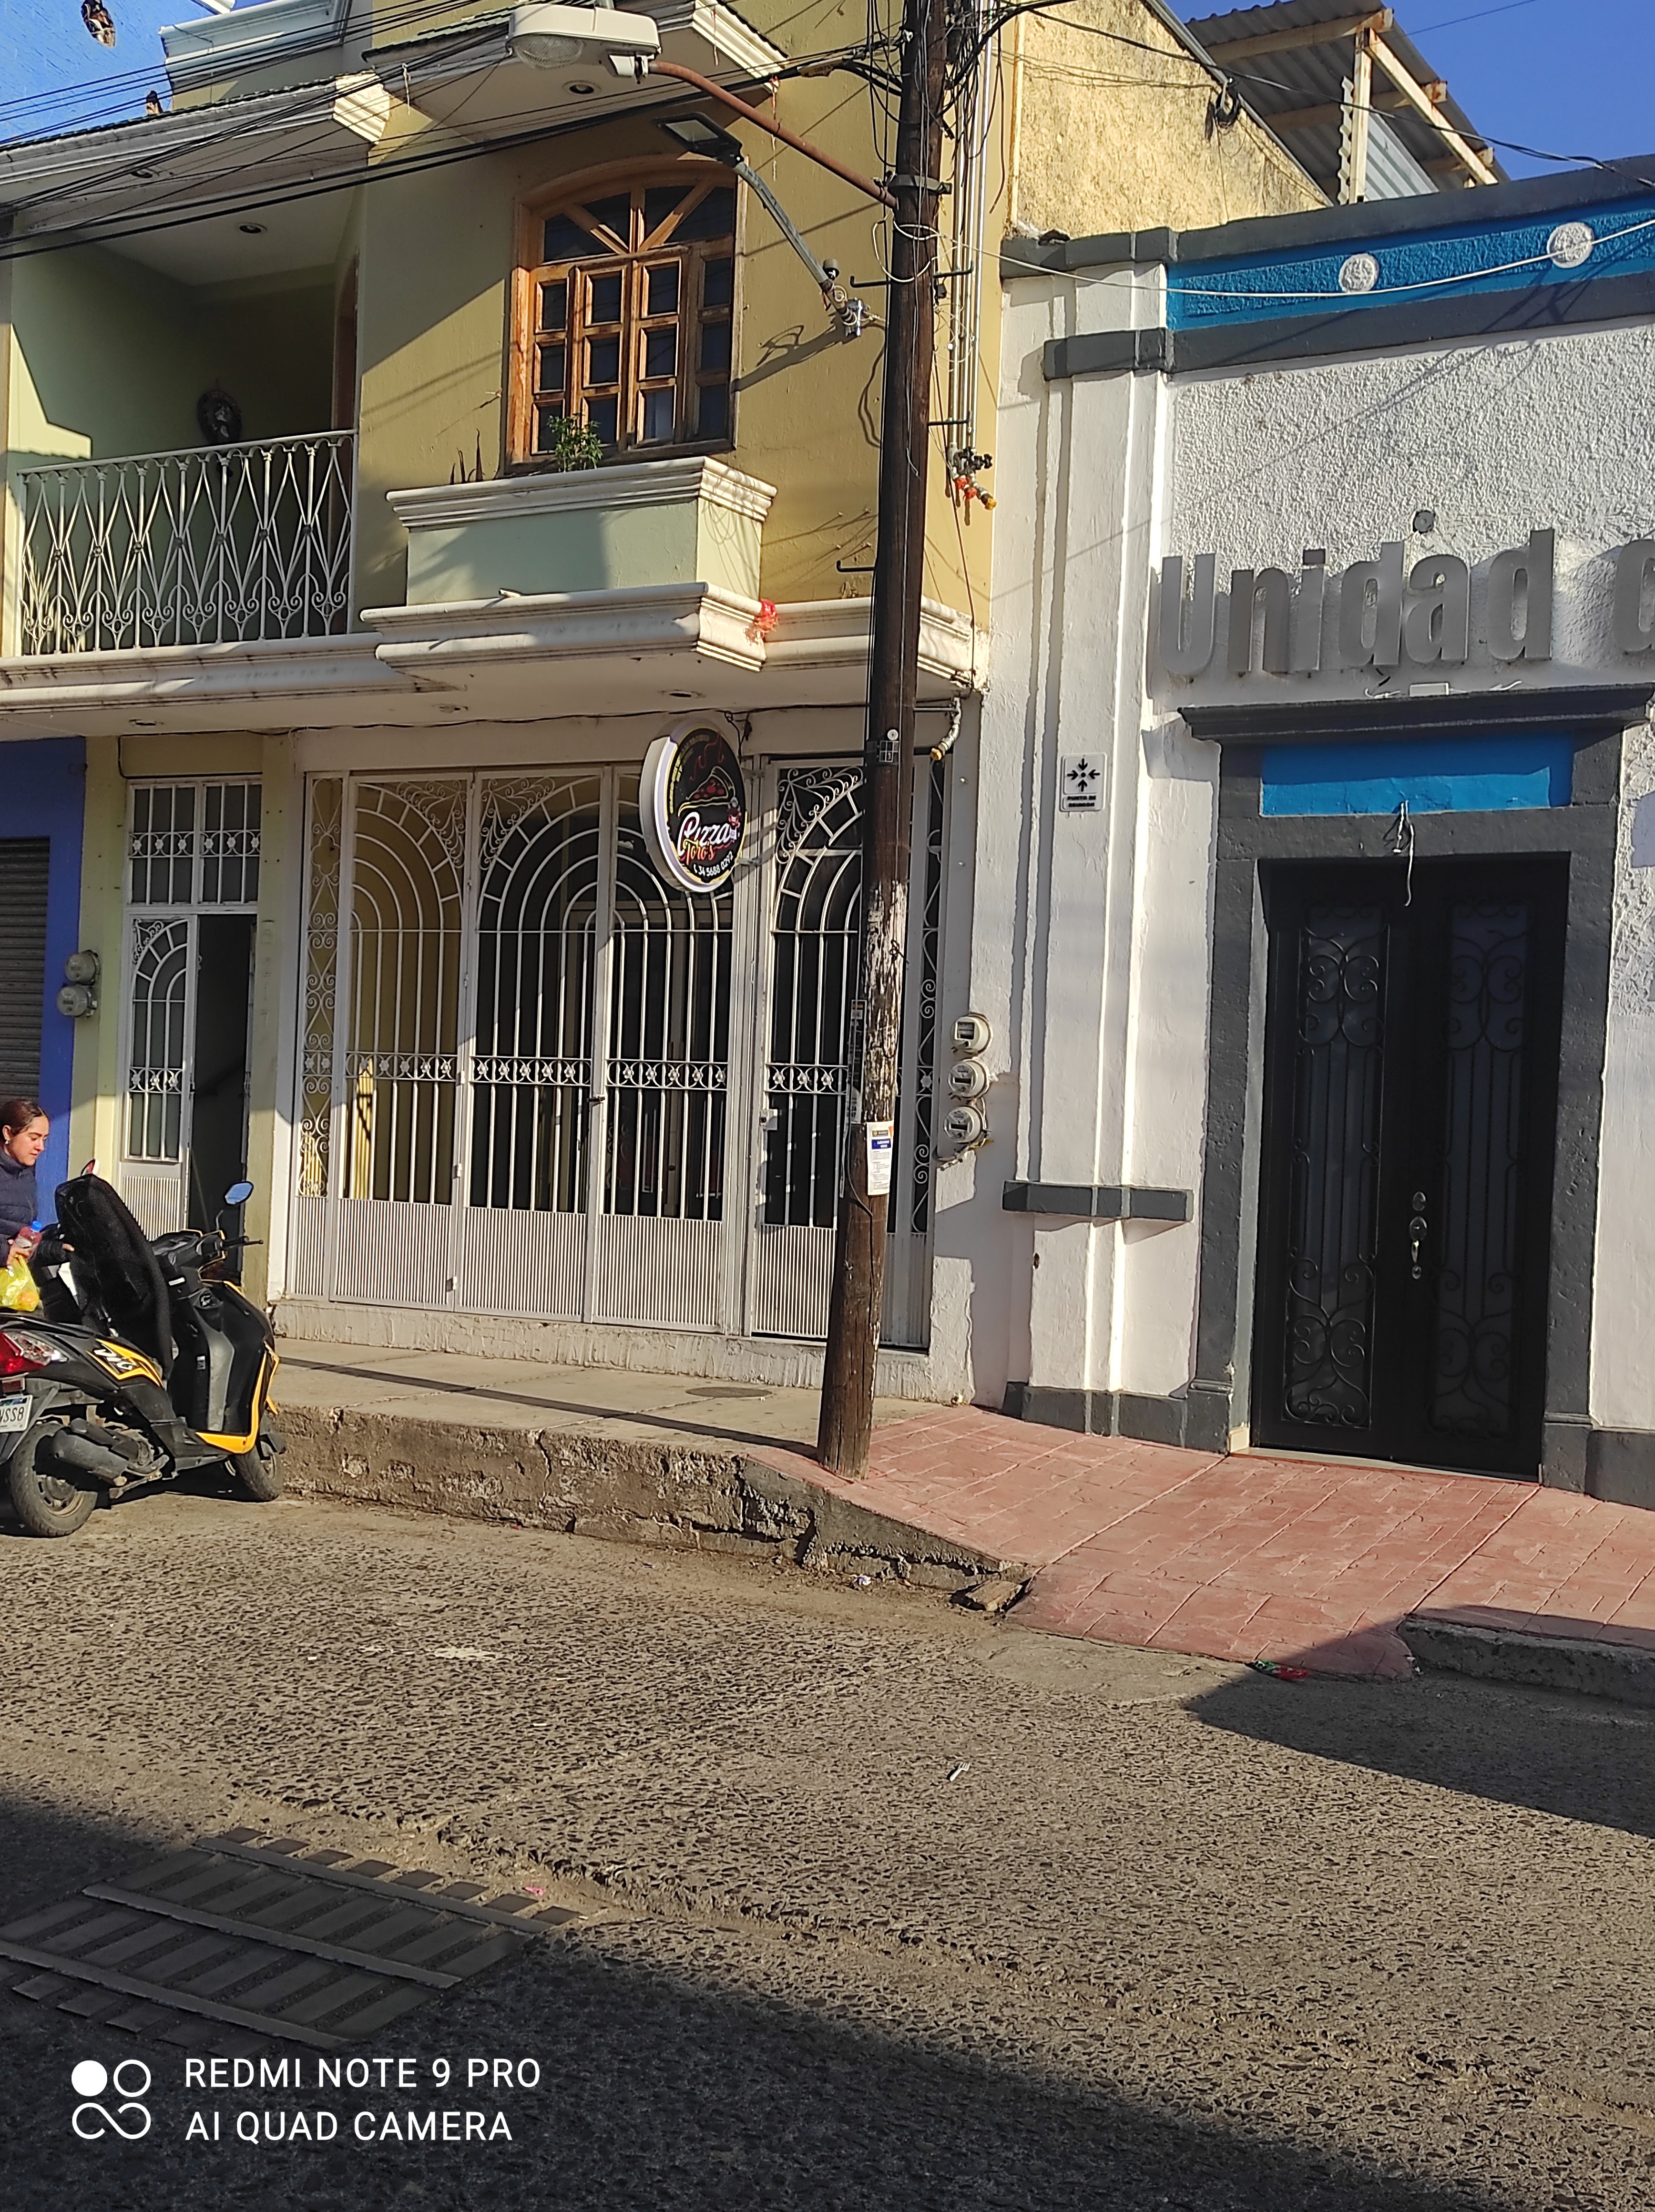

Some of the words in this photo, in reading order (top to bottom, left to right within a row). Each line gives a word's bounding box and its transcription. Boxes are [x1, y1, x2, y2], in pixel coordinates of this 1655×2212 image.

[1159, 529, 1554, 675] Unidad
[677, 811, 731, 857] Pizza
[683, 839, 715, 866] Toro's
